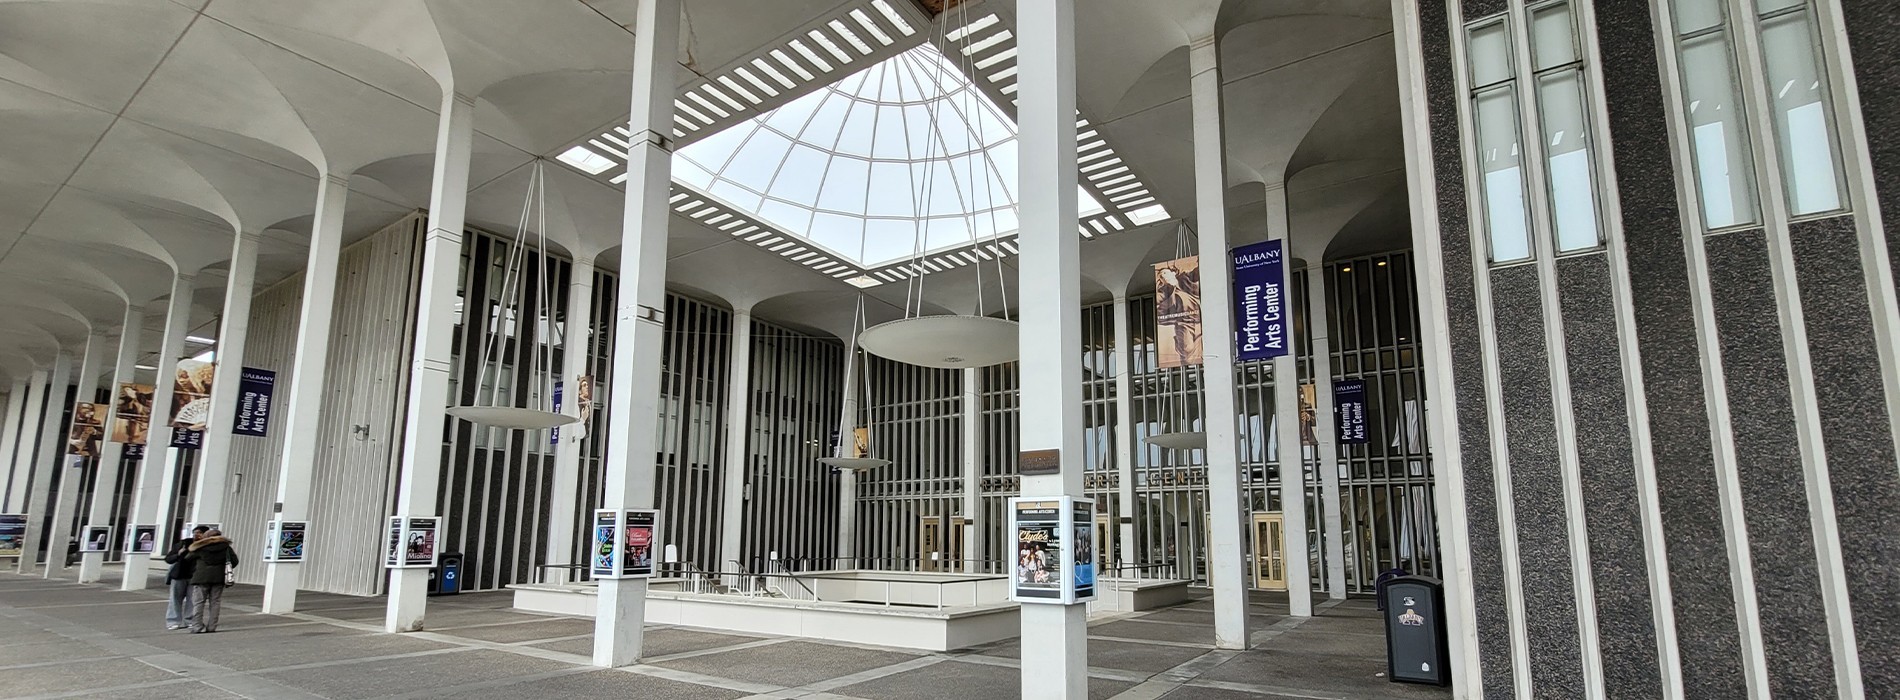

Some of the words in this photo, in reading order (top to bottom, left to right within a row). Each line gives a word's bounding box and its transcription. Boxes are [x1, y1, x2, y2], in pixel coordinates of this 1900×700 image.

[1235, 249, 1280, 264] UALBANY
[1263, 282, 1280, 321] Center
[1241, 284, 1261, 352] Performing
[1265, 324, 1282, 349] Arts
[236, 391, 257, 431] Performing
[253, 393, 269, 417] Center
[1353, 402, 1363, 424] Center
[251, 417, 265, 433] Arts
[1340, 402, 1351, 440] Performing
[1353, 425, 1364, 439] Arts
[1085, 474, 1118, 488] ART
[1150, 471, 1200, 485] CENT
[1019, 530, 1048, 543] Clyde's
